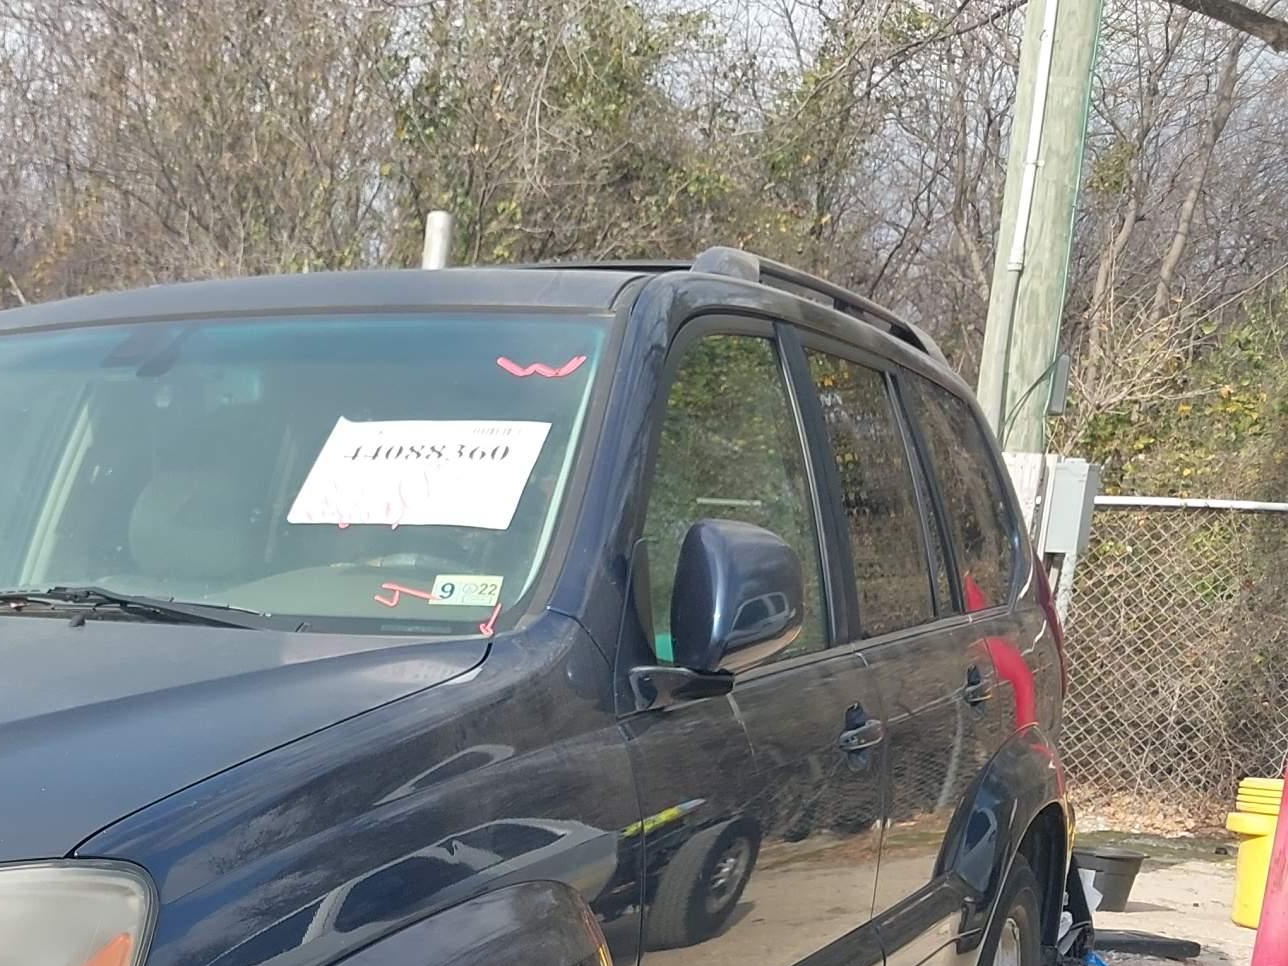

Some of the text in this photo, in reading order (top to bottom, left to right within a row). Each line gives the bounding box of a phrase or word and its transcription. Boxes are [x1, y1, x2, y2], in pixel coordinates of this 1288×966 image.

[343, 444, 510, 461] 44088360
[439, 582, 498, 600] 9 22
